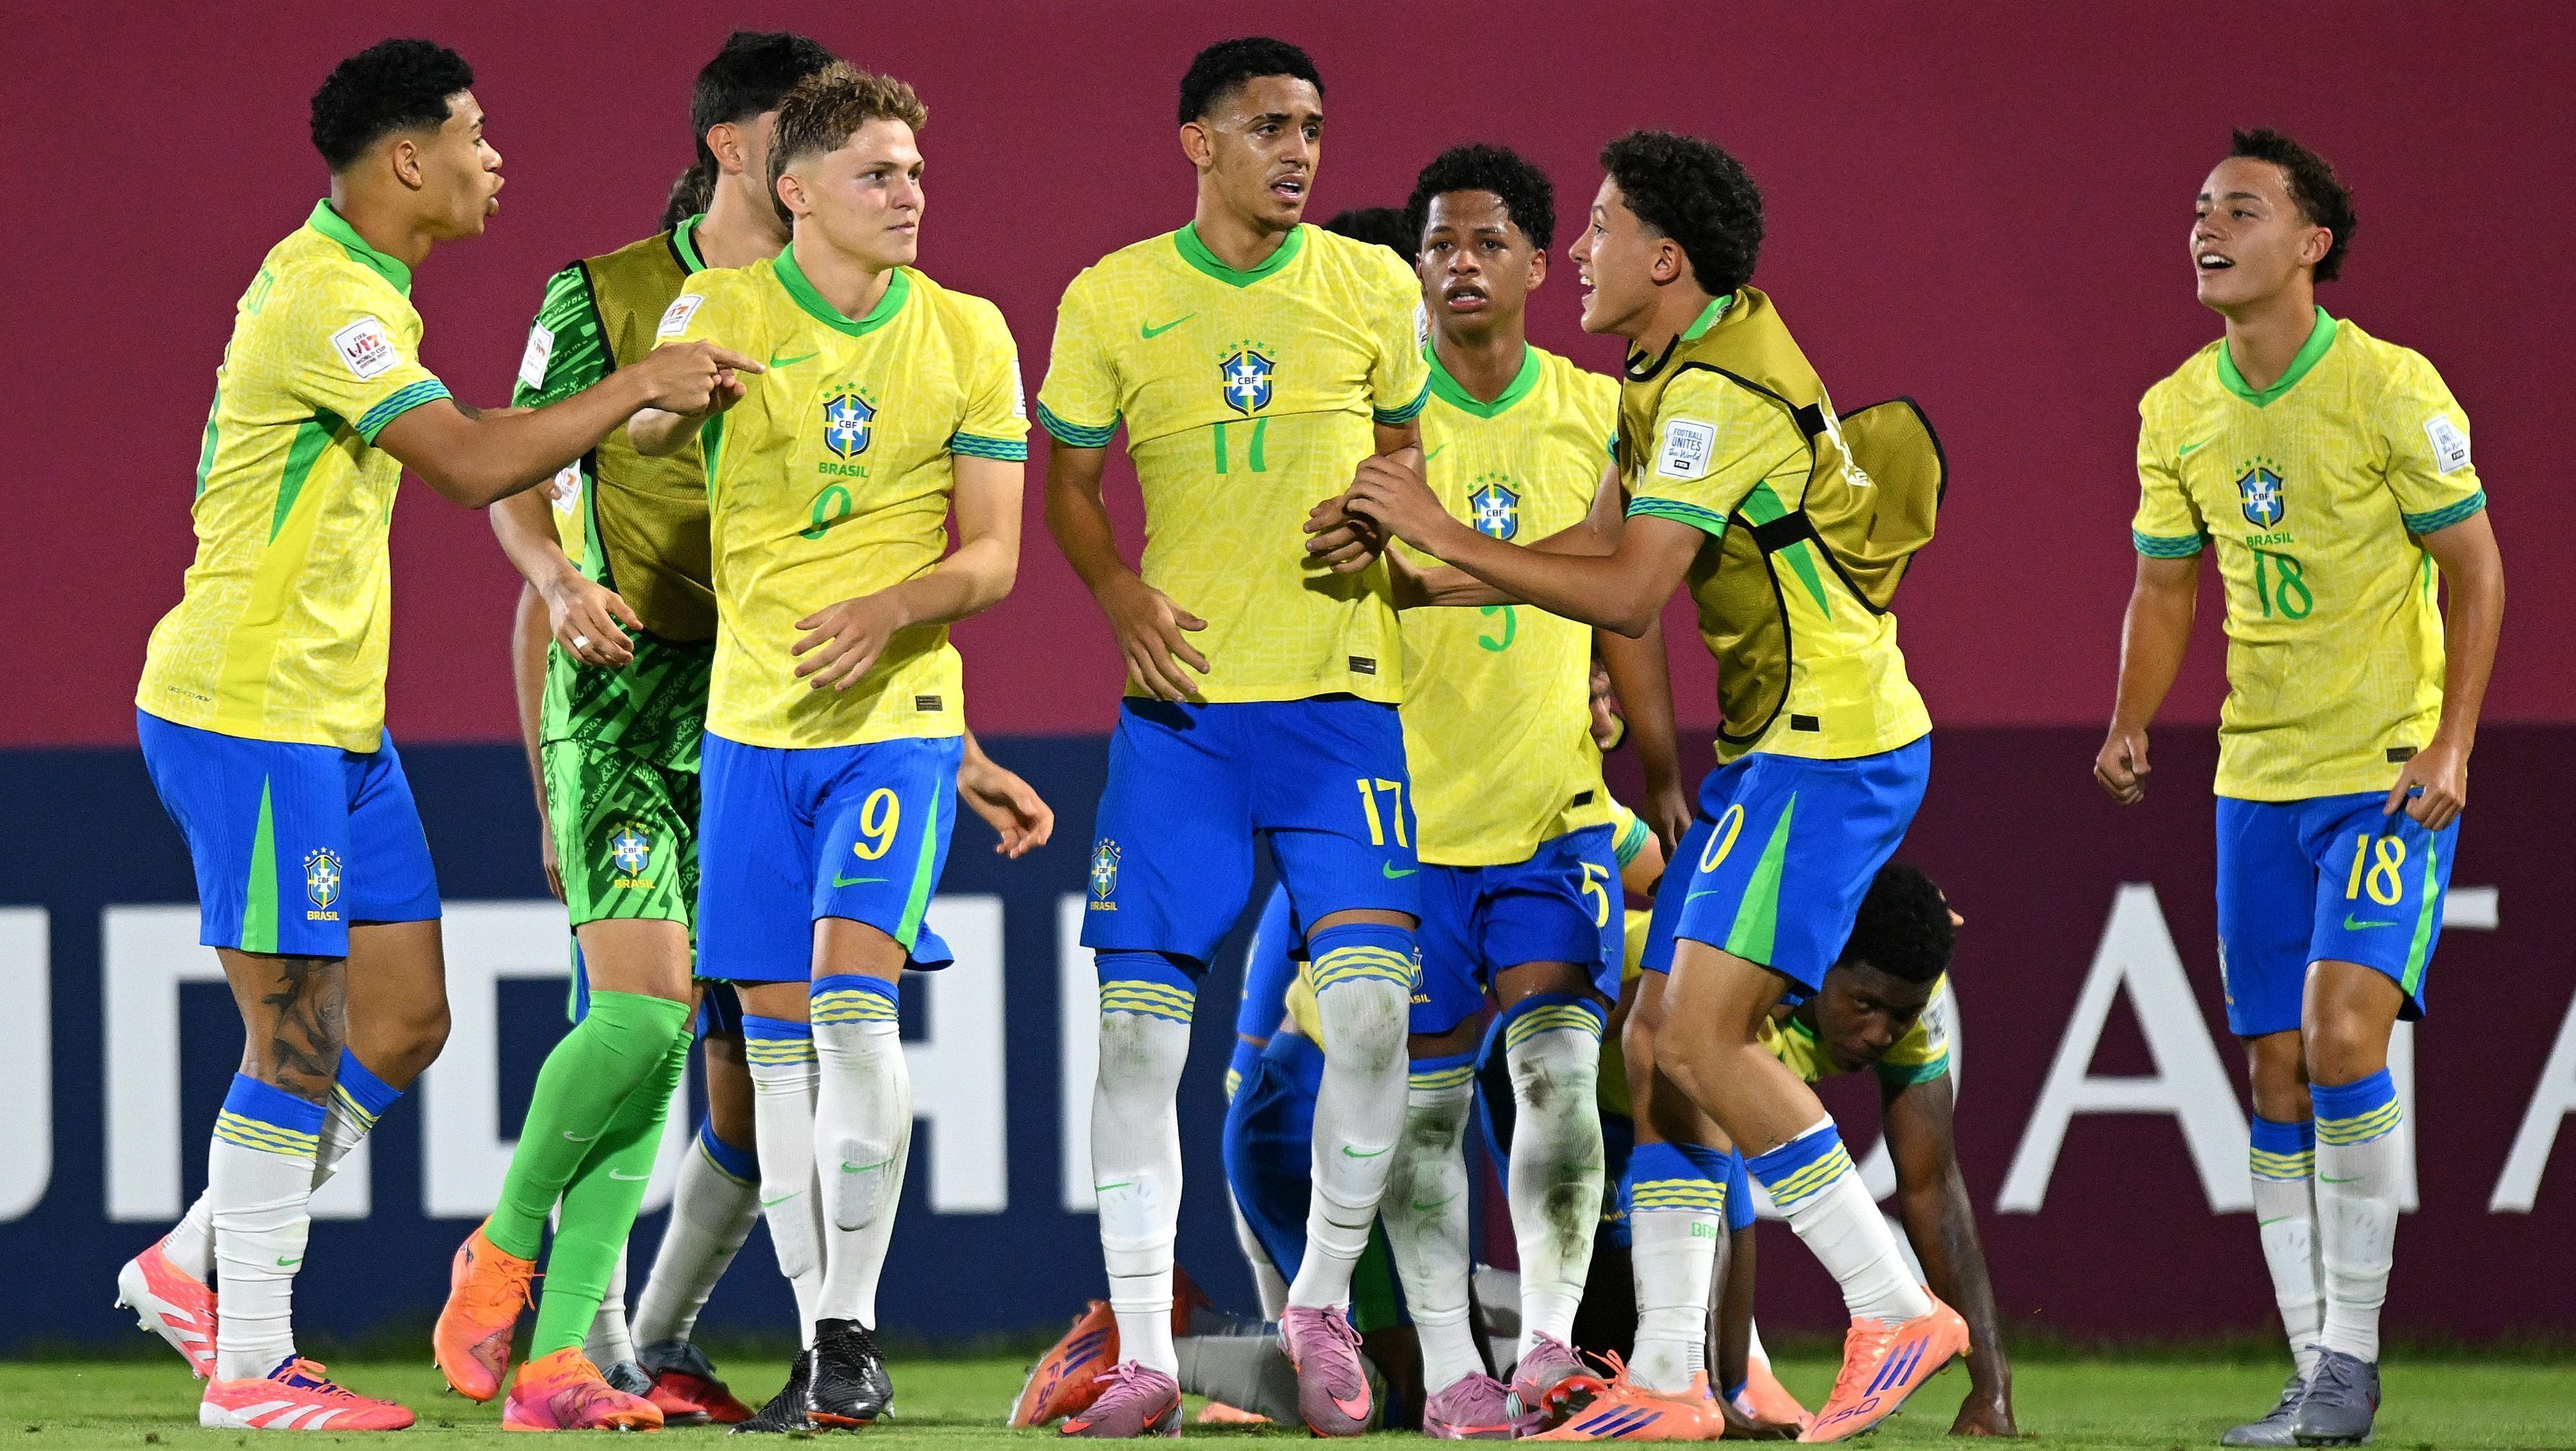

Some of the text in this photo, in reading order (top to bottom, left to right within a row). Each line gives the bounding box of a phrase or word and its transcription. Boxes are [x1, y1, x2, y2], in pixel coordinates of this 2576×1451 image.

[347, 334, 380, 358] U17
[355, 351, 376, 365] WORLD
[1238, 376, 1257, 385] CBF
[839, 419, 858, 430] CBF
[1674, 428, 1703, 441] FOOTBALL
[1671, 436, 1702, 451] UNITES
[1680, 449, 1702, 460] World
[819, 462, 869, 478] BRASIL
[2253, 493, 2270, 501] CBF
[2246, 532, 2294, 548] BRASIL
[2254, 549, 2313, 621] 18
[1357, 778, 1409, 848] 17
[853, 787, 900, 861] 9
[2346, 834, 2407, 906] 18
[614, 879, 656, 889] BRASIL
[1578, 861, 1609, 928] 5
[1090, 901, 1118, 911] BRASIL
[307, 910, 340, 921] BRASIL
